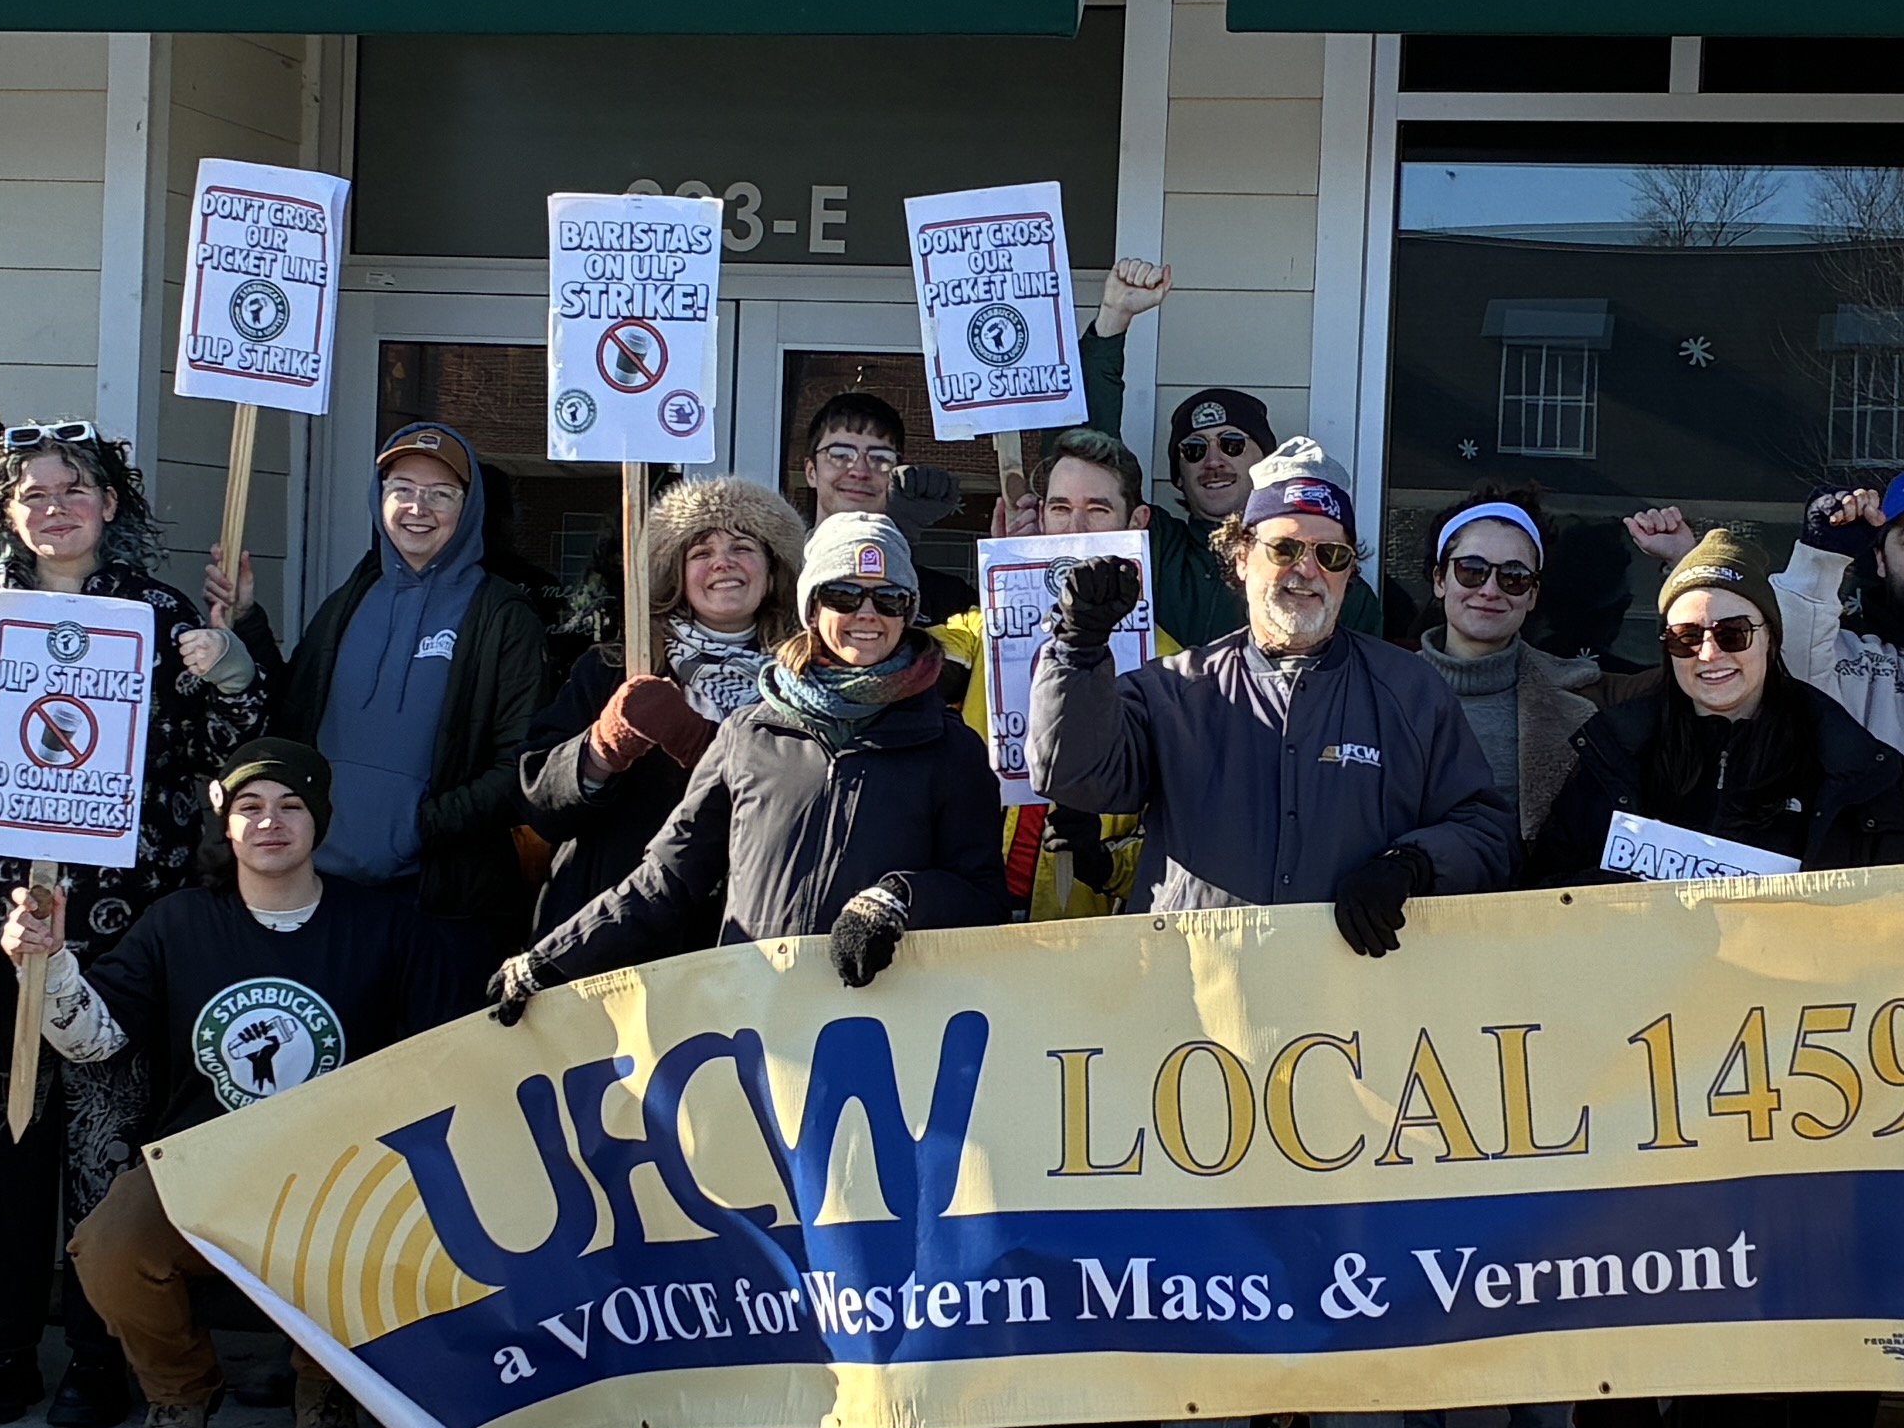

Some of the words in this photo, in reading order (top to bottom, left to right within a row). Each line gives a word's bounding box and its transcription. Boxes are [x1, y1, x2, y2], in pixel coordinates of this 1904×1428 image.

[201, 193, 264, 224] DON'T
[268, 203, 327, 234] CROSS
[626, 178, 848, 253] 3-E
[246, 225, 288, 253] OUR
[560, 221, 712, 255] BARISTAS
[918, 225, 983, 256] DON'T
[987, 220, 1055, 248] CROSS
[196, 243, 277, 278] PICKET
[281, 255, 328, 287] LINE
[584, 254, 625, 280] ON
[631, 254, 686, 282] ULP
[968, 249, 1013, 274] OUR
[560, 281, 710, 322] STRIKE!
[923, 273, 1007, 308] PICKET
[1012, 270, 1060, 299] LINE
[186, 335, 233, 366] ULP
[238, 343, 321, 382] STRIKE
[933, 372, 982, 404] ULP
[987, 364, 1072, 397] STRIKE
[985, 604, 1042, 639] ULP
[44, 664, 145, 703] STRIKE
[992, 711, 1026, 739] NO
[14, 763, 135, 801] CONTRACT,
[7, 793, 134, 831] STARBUCKS!
[1608, 835, 1760, 881] BARIST
[212, 987, 329, 1032] STARBUCKS
[199, 1046, 254, 1107] WORKER
[375, 1009, 990, 1290] UFCW
[1048, 1021, 1592, 1179] LOCAL
[493, 1345, 537, 1386] a
[537, 1280, 735, 1361] VOICE
[734, 1277, 801, 1336] for
[800, 1271, 1049, 1335] Western
[1073, 1257, 1295, 1322] Mass.
[1319, 1251, 1390, 1319] &
[1410, 1229, 1759, 1315] Vermont
